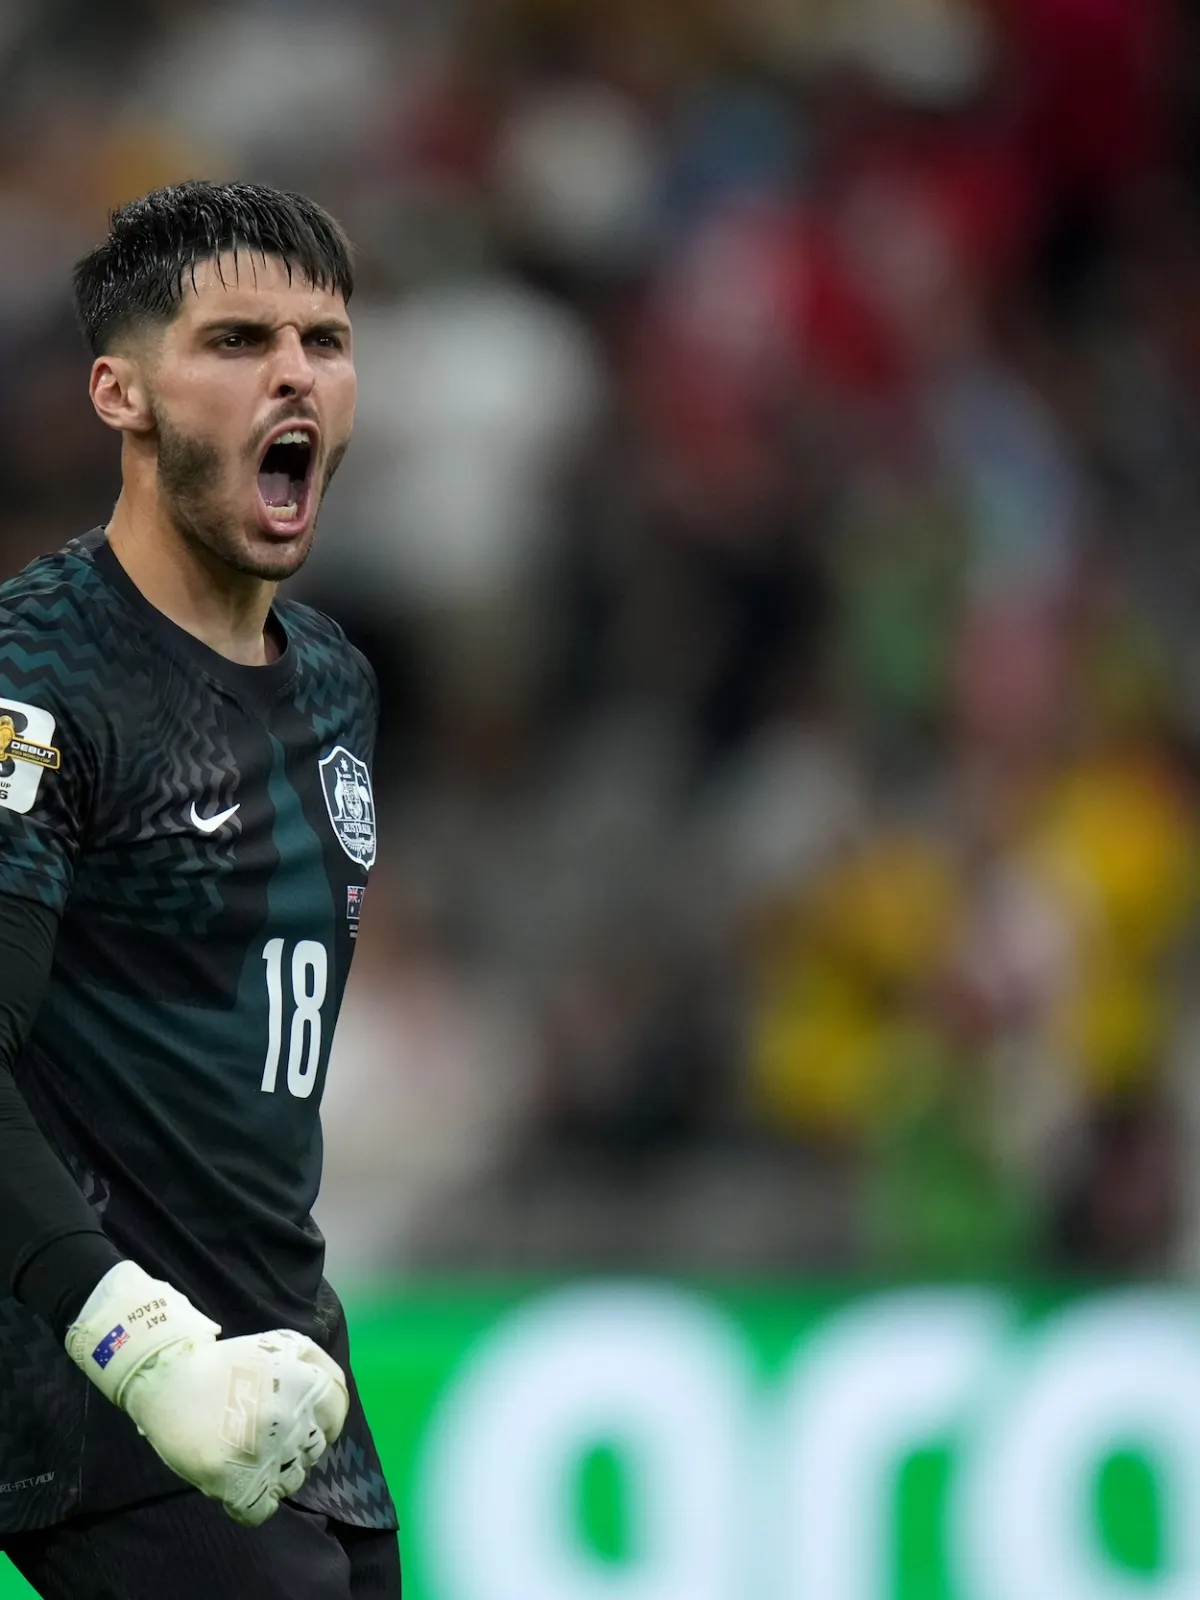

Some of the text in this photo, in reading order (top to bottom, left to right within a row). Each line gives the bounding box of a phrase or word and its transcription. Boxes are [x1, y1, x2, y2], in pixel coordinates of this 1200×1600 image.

[10, 741, 55, 759] DEBUT
[260, 937, 328, 1099] 18
[127, 1298, 167, 1324] BEACH
[146, 1312, 167, 1330] PAT
